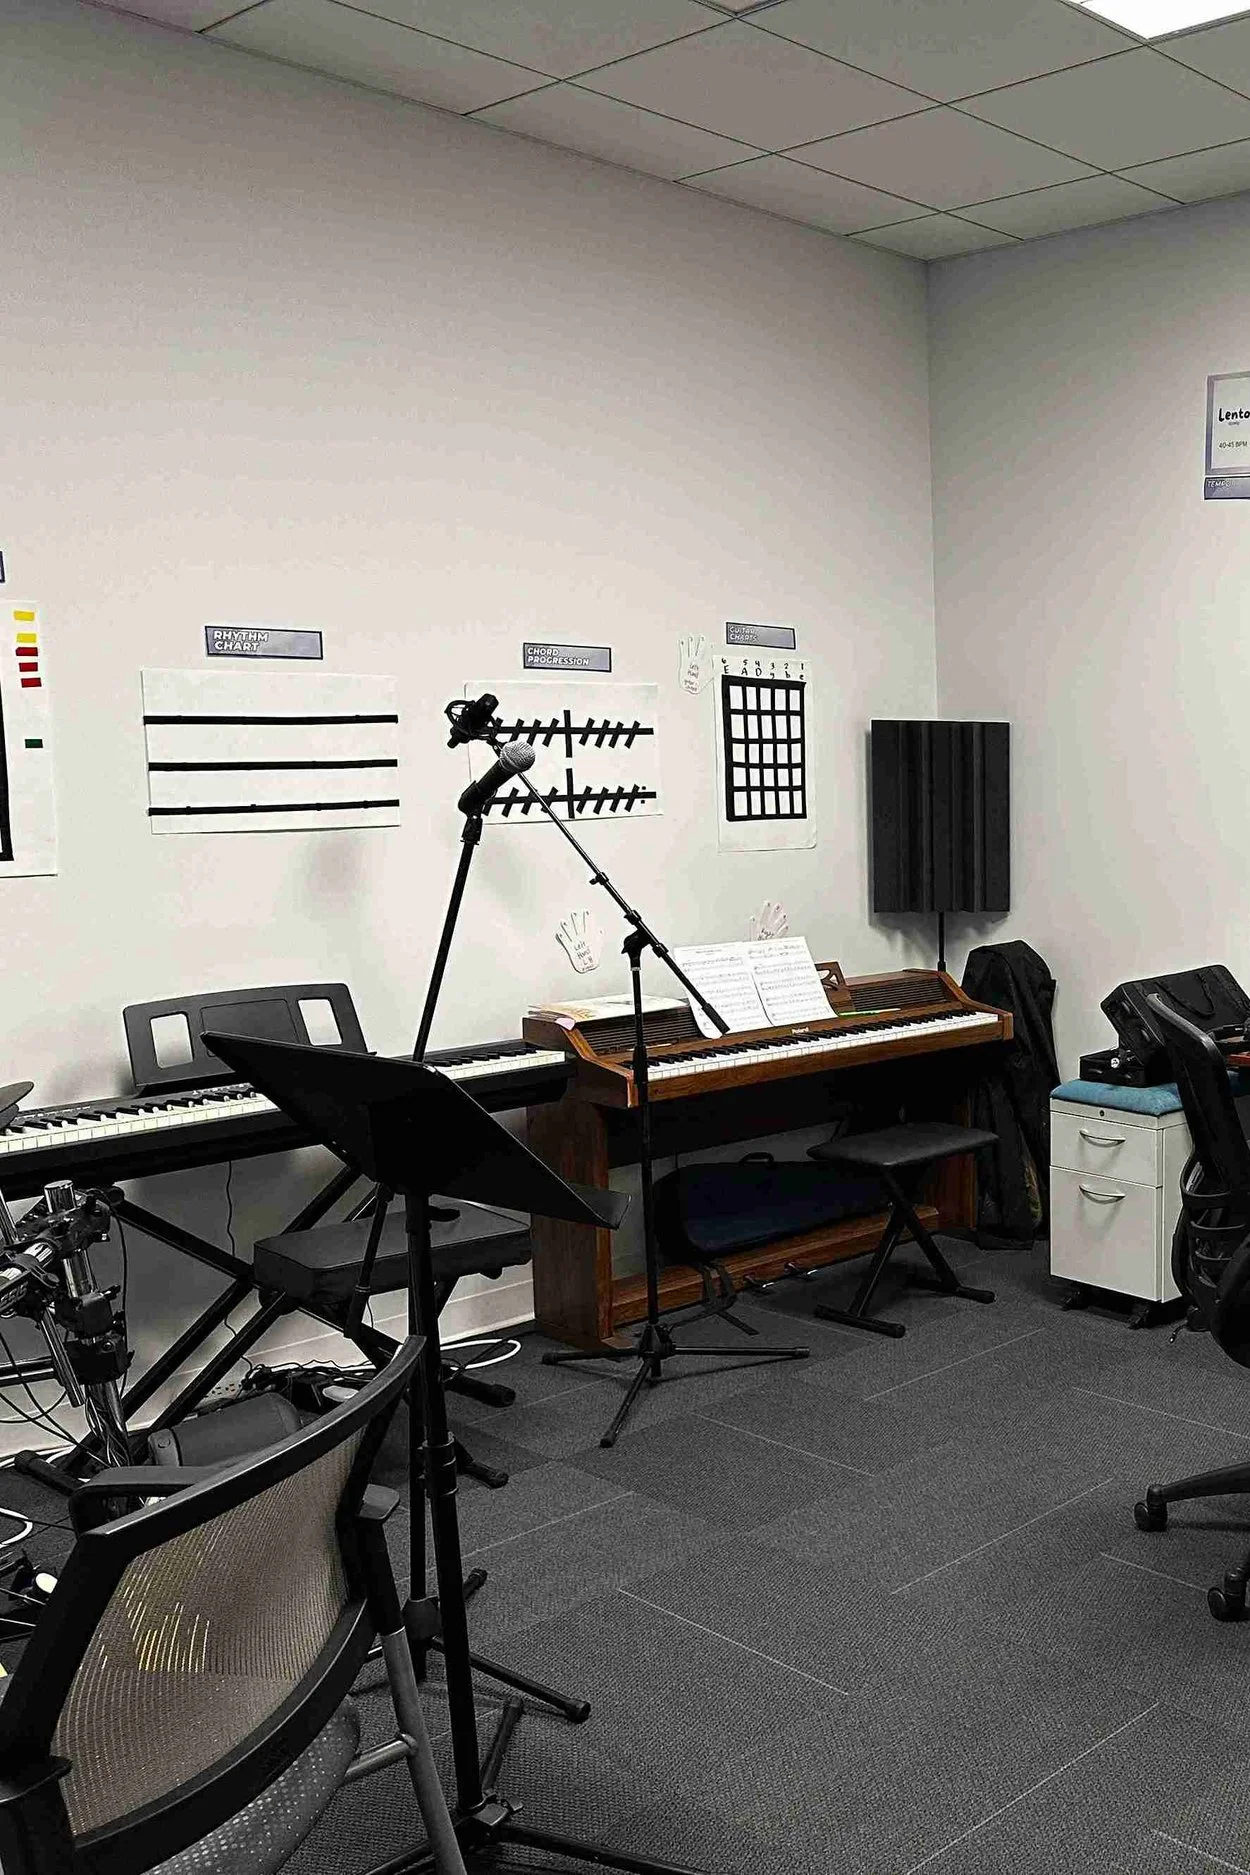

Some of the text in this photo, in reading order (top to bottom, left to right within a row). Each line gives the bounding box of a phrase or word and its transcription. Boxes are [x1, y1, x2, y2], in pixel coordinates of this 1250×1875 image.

[1218, 407, 1250, 422] Lento
[213, 630, 269, 642] RHYTHM
[214, 641, 259, 651] CHART
[527, 647, 559, 656] CHORD
[527, 655, 589, 666] PROGRESSION
[724, 665, 729, 674] E
[741, 667, 748, 676] A
[756, 667, 762, 676] D
[785, 670, 791, 678] b
